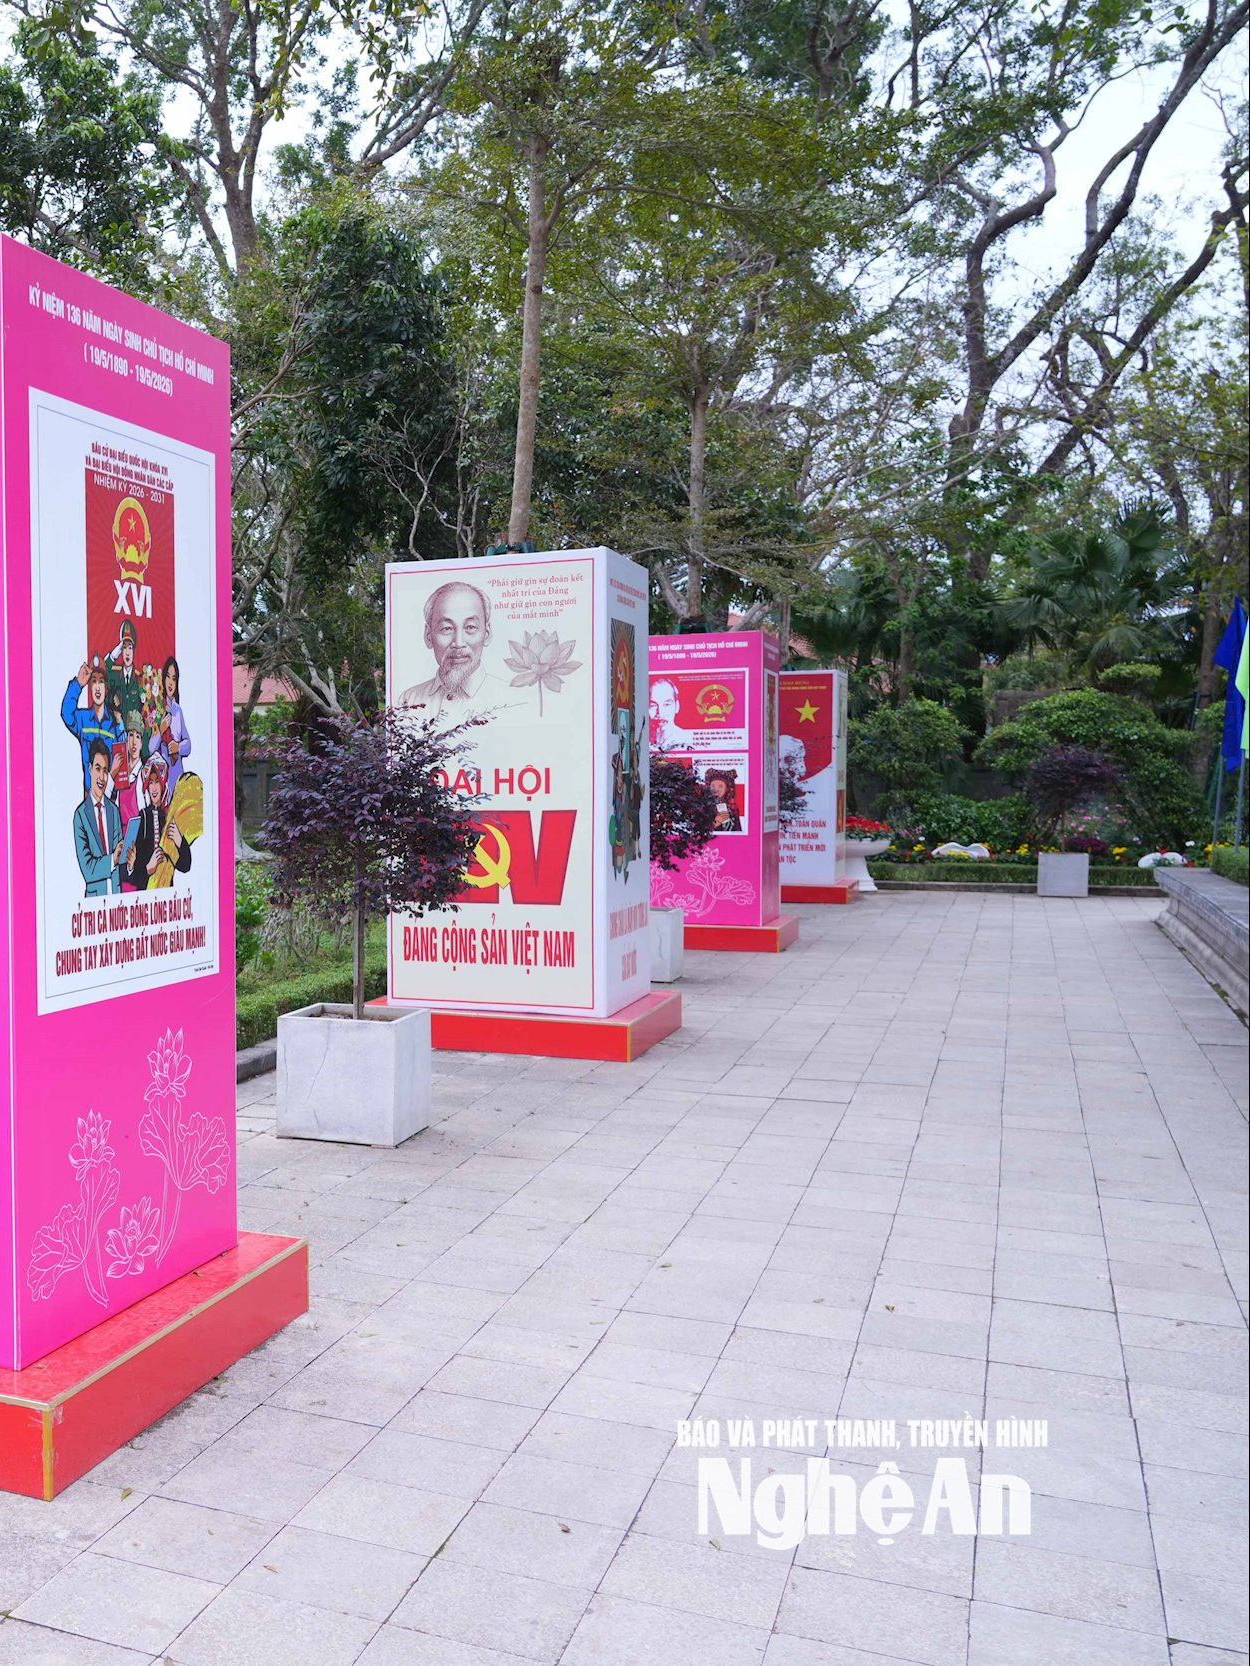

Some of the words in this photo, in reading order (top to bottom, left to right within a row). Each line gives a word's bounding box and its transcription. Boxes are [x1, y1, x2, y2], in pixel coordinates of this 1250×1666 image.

[29, 281, 41, 307] KỶ
[43, 290, 64, 320] NIỆM
[67, 303, 80, 326] 136
[83, 310, 100, 335] NĂM
[103, 321, 123, 344] NGÀY
[125, 330, 141, 353] SINH
[143, 337, 157, 360] CHỦ
[159, 345, 173, 367] TỊCH
[175, 349, 183, 372] HỒ
[185, 357, 196, 377] CHÍ
[197, 364, 214, 384] MINH
[90, 346, 128, 377] 19/5/1890
[135, 365, 172, 397] 19/5/2026)
[94, 473, 116, 490] NHIỆM
[119, 479, 127, 492] KỲ
[129, 485, 144, 498] 2026
[151, 491, 164, 504] 2031
[114, 580, 152, 618] XVI
[494, 764, 550, 801] HỘI
[72, 903, 83, 938] CỬ
[84, 909, 95, 936] TRI
[98, 899, 107, 933] CẢ
[109, 900, 128, 931] NƯỚC
[130, 897, 148, 928] ĐỒNG
[151, 896, 167, 925] LÒNG
[169, 890, 181, 922] BẦU
[183, 888, 193, 921] CỬ,
[56, 947, 82, 976] CHUNG
[84, 945, 97, 971] TAY
[100, 938, 114, 968] XÂY
[116, 938, 134, 969] DỰNG
[136, 928, 149, 960] ĐẤT
[151, 927, 168, 957] NƯỚC
[170, 926, 184, 954] GIÀU
[186, 926, 205, 954] MẠNH!
[403, 916, 437, 961] ĐẢNG
[442, 920, 476, 971] CỘNG
[481, 913, 507, 965] SẢN
[512, 922, 539, 974] VIỆT
[544, 931, 575, 968] NAM
